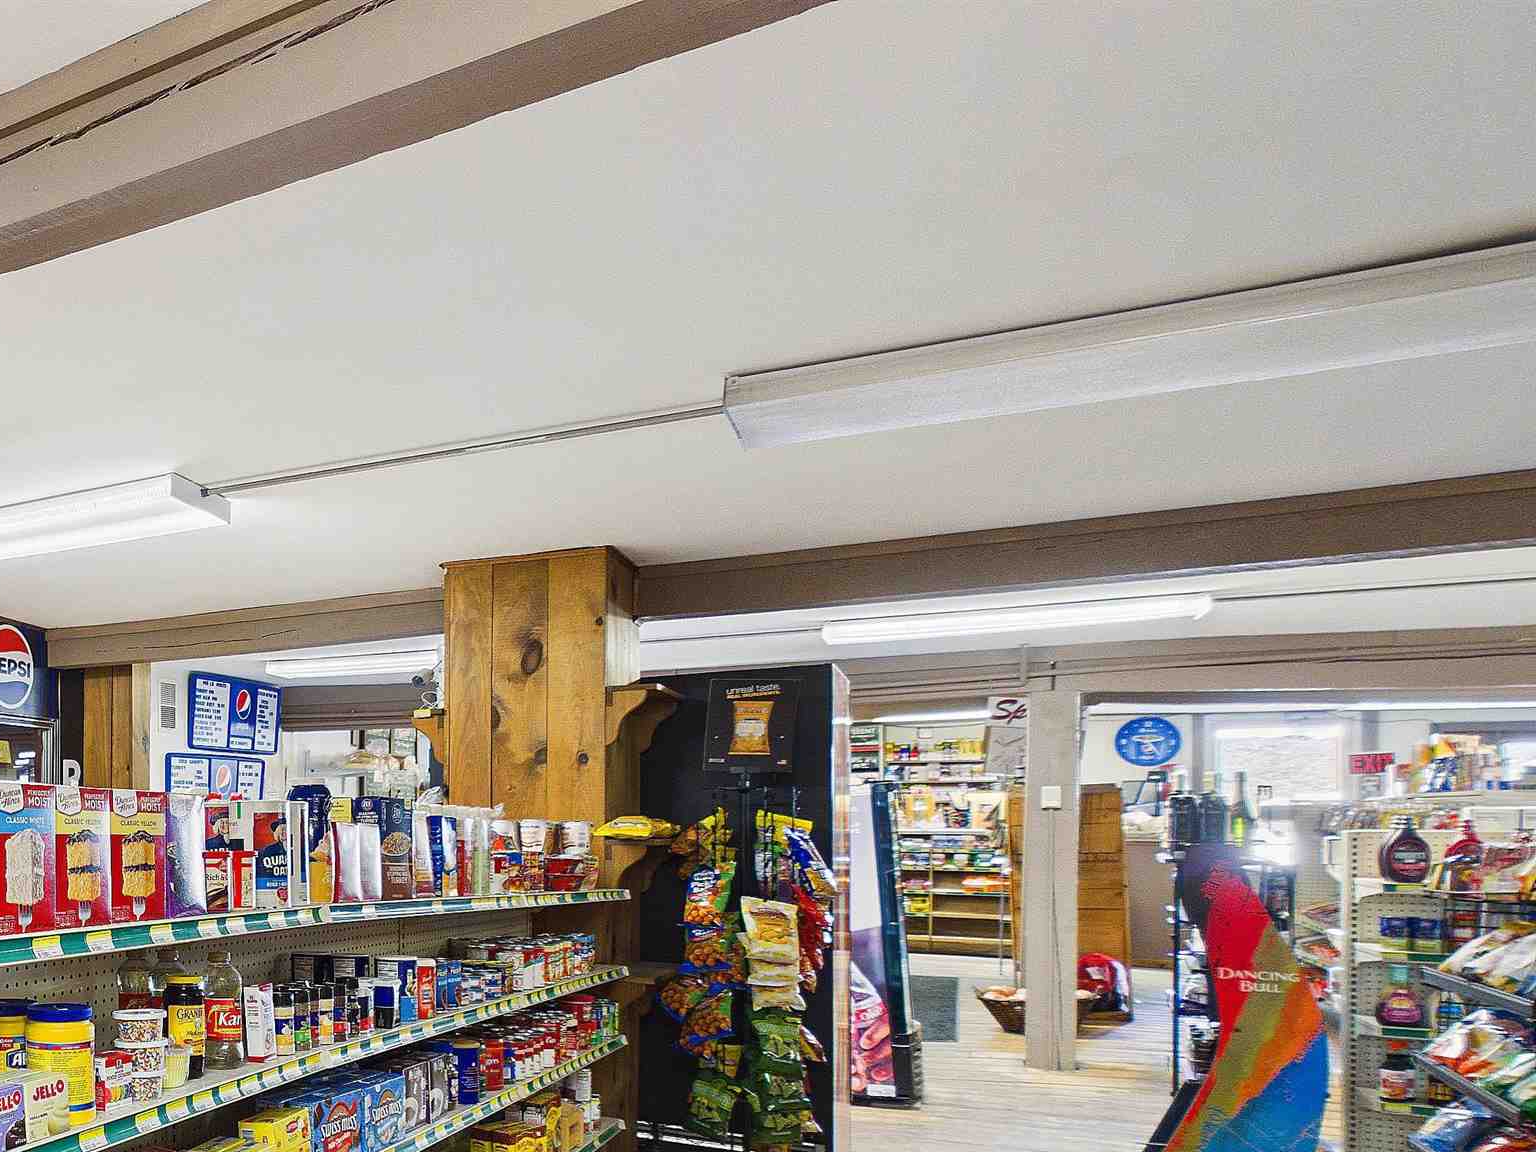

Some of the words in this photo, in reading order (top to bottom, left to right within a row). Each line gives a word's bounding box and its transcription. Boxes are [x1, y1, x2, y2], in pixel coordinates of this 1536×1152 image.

[27, 796, 52, 808] MOIST
[84, 800, 105, 810] MOIST
[140, 802, 162, 812] MOIST
[5, 816, 28, 825] CLASSIC
[1216, 967, 1301, 983] DANCING
[1239, 979, 1281, 993] BULL
[32, 1079, 66, 1102] JELL-O
